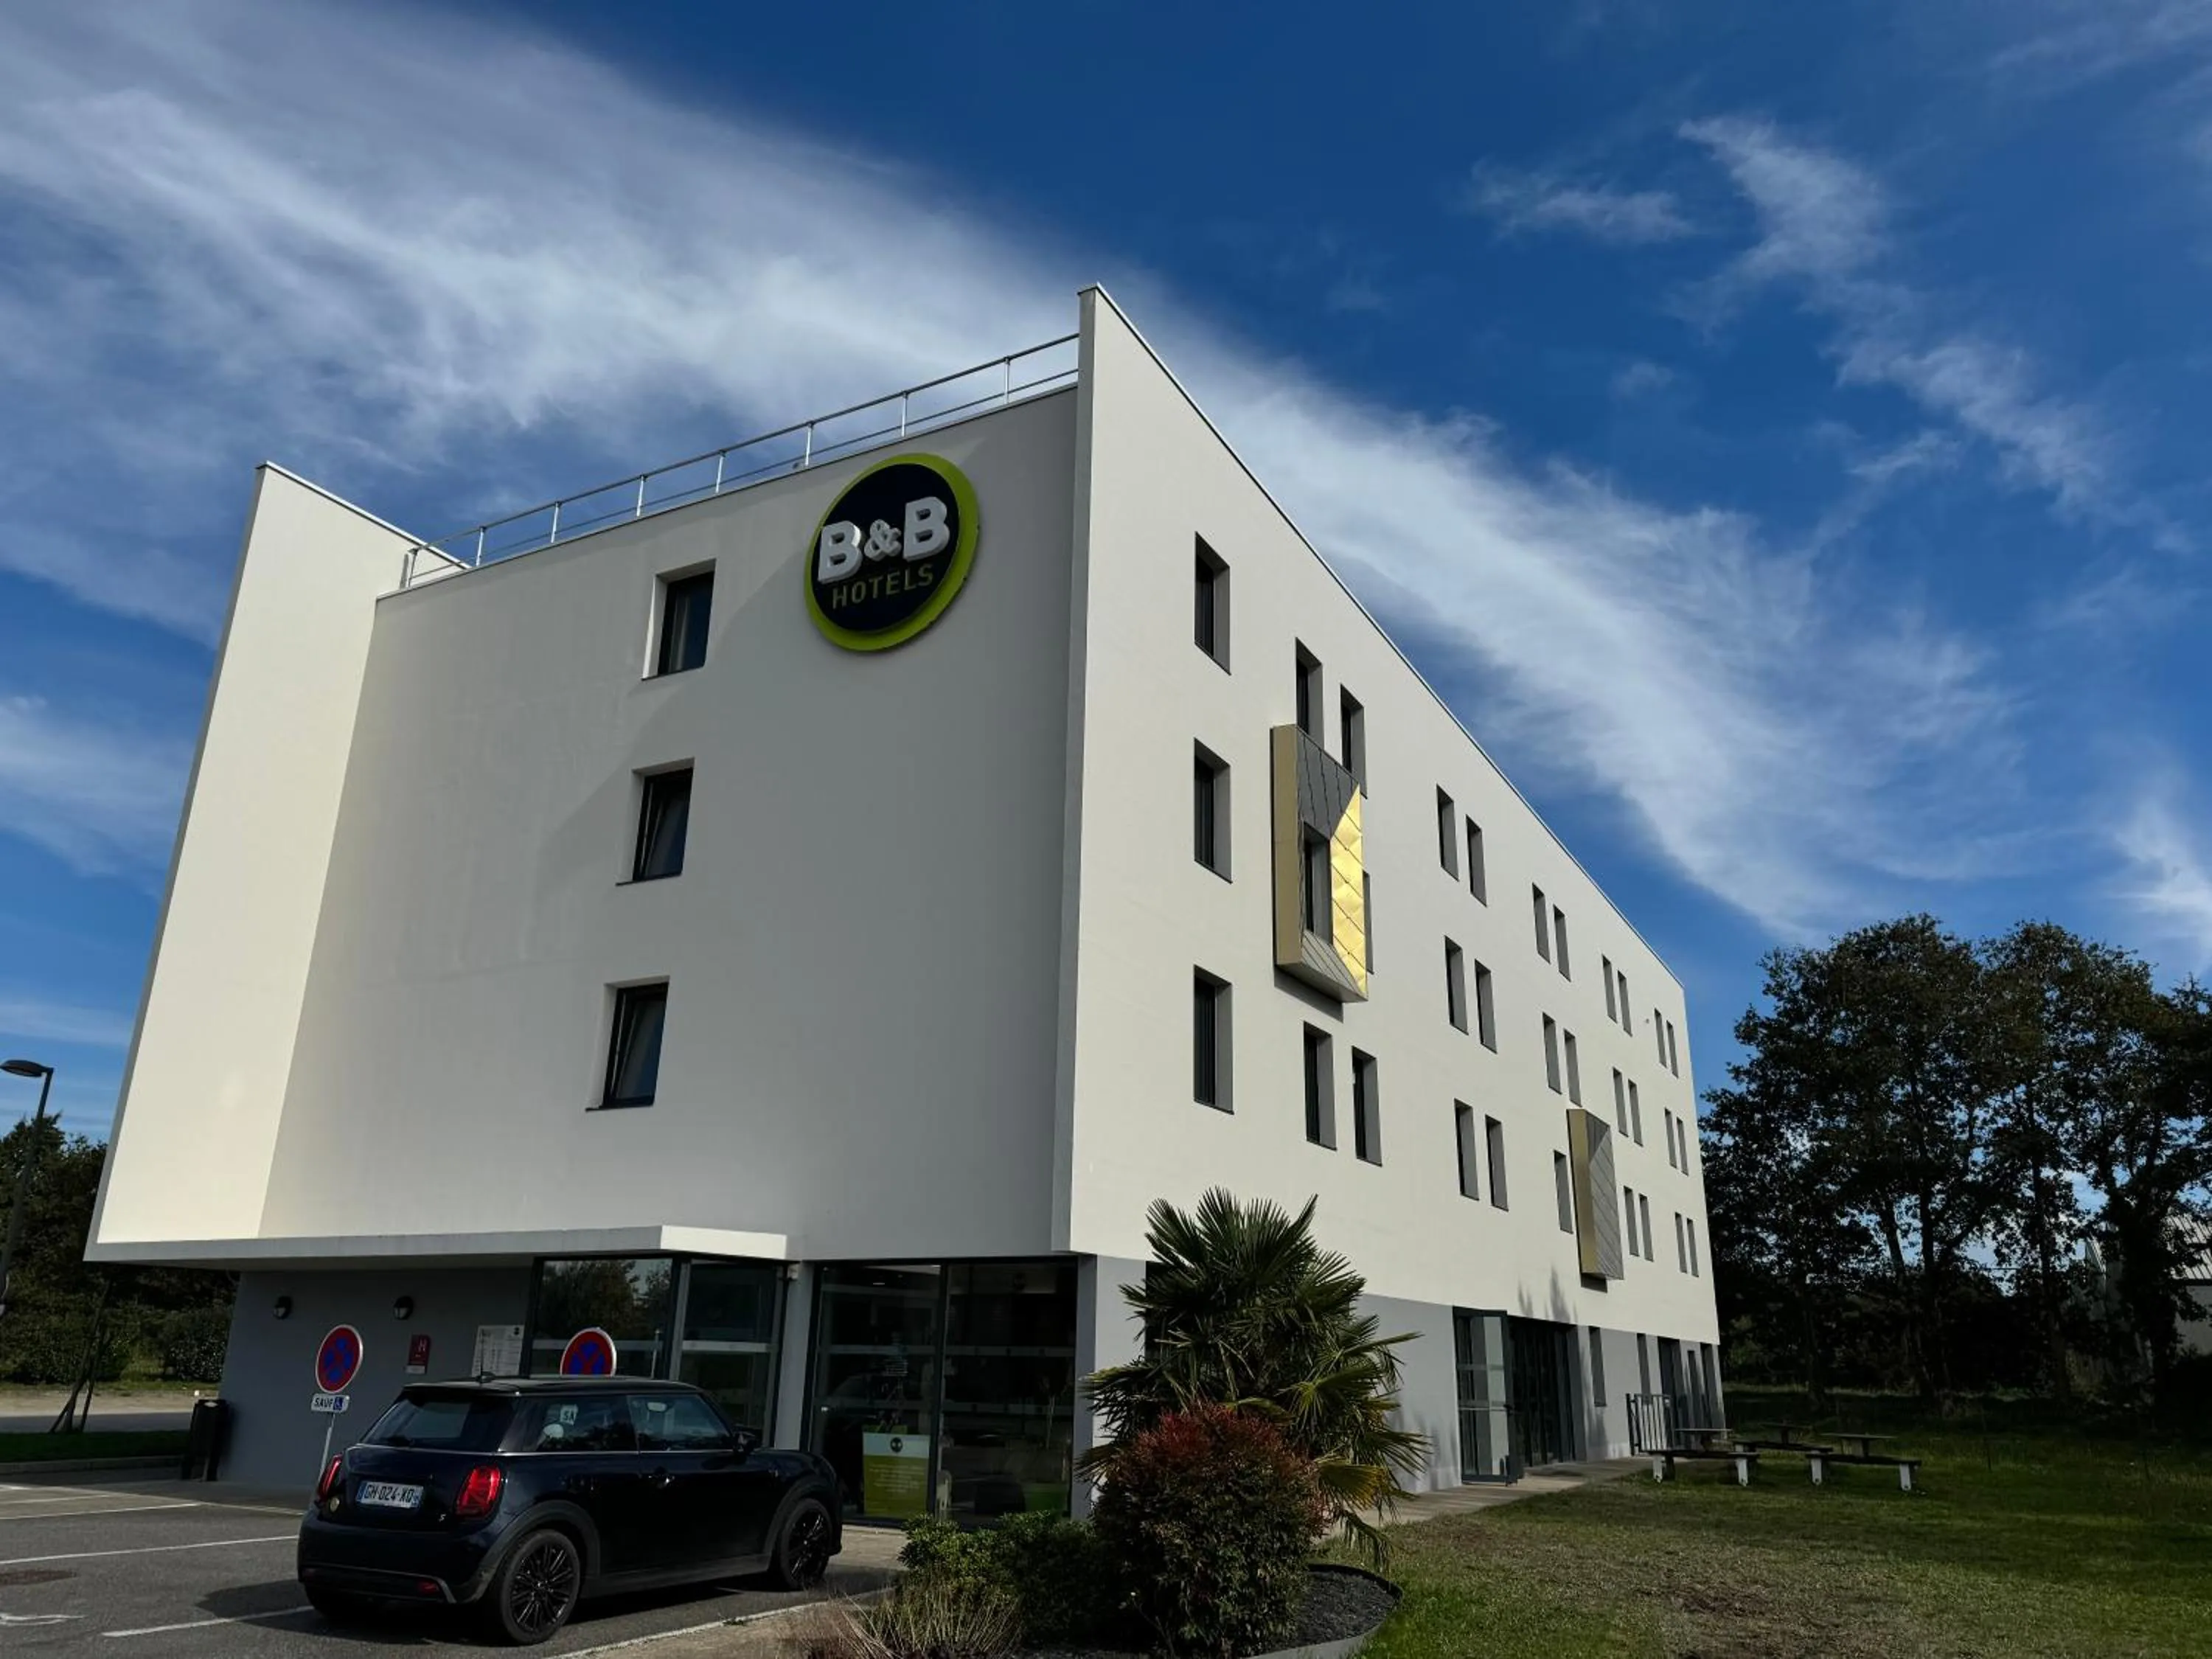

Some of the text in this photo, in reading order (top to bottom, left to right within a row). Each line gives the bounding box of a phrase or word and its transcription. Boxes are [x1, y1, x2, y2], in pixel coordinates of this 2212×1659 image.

[818, 496, 950, 584] B&B
[832, 564, 933, 610] HOTELS
[314, 1397, 334, 1408] SAUF
